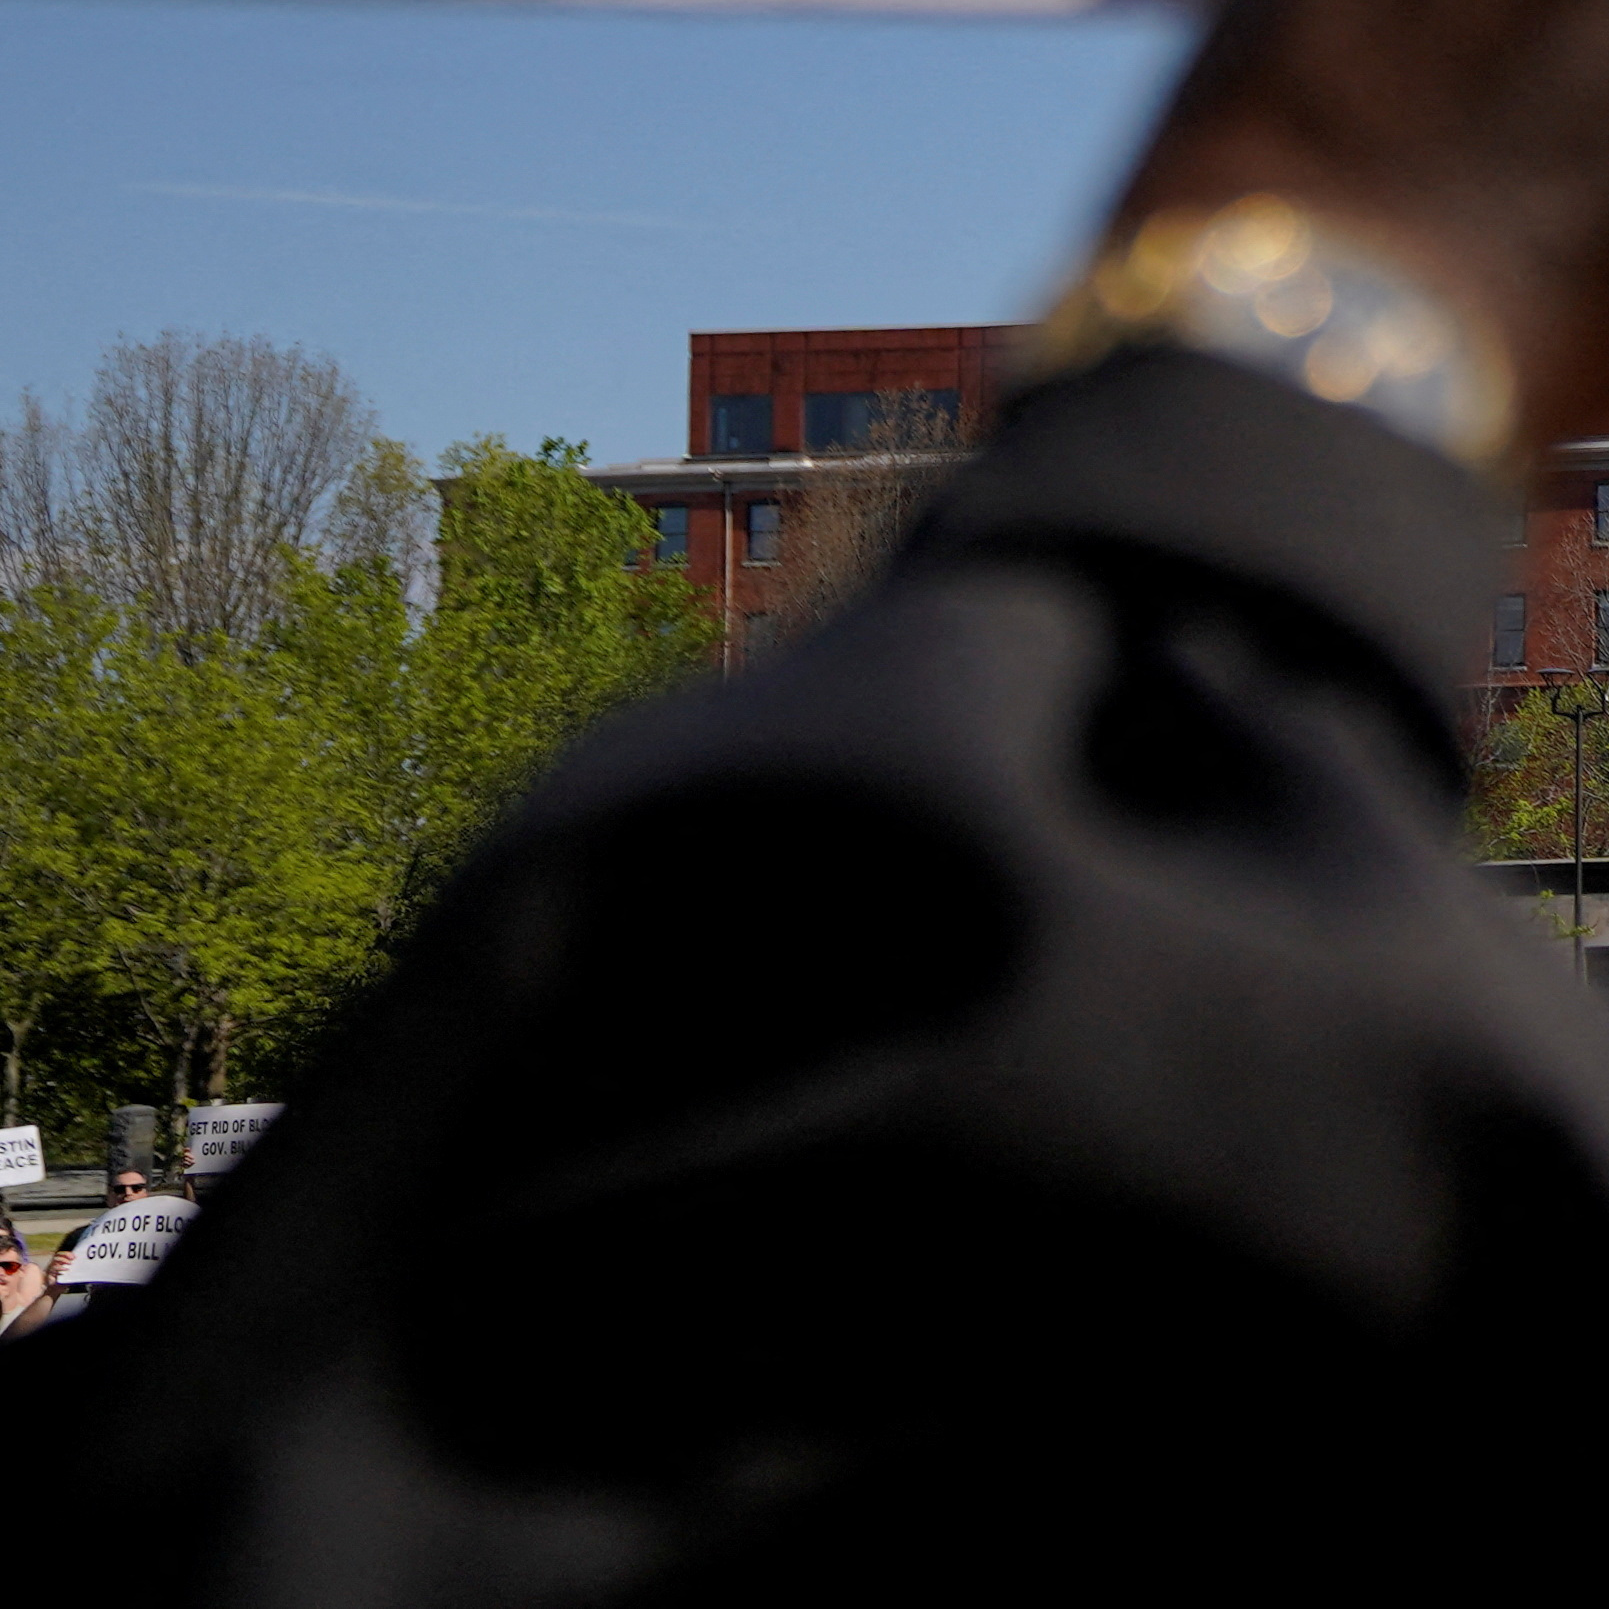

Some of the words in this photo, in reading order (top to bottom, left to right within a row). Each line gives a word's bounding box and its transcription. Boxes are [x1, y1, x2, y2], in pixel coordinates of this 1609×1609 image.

[189, 1121, 208, 1136] GET
[211, 1120, 229, 1135] RID
[232, 1119, 246, 1133] OF
[202, 1141, 228, 1156] GOV.
[101, 1217, 127, 1235] RID
[132, 1215, 152, 1232] OF
[86, 1243, 122, 1261] GOV.
[126, 1241, 161, 1261] BILL
